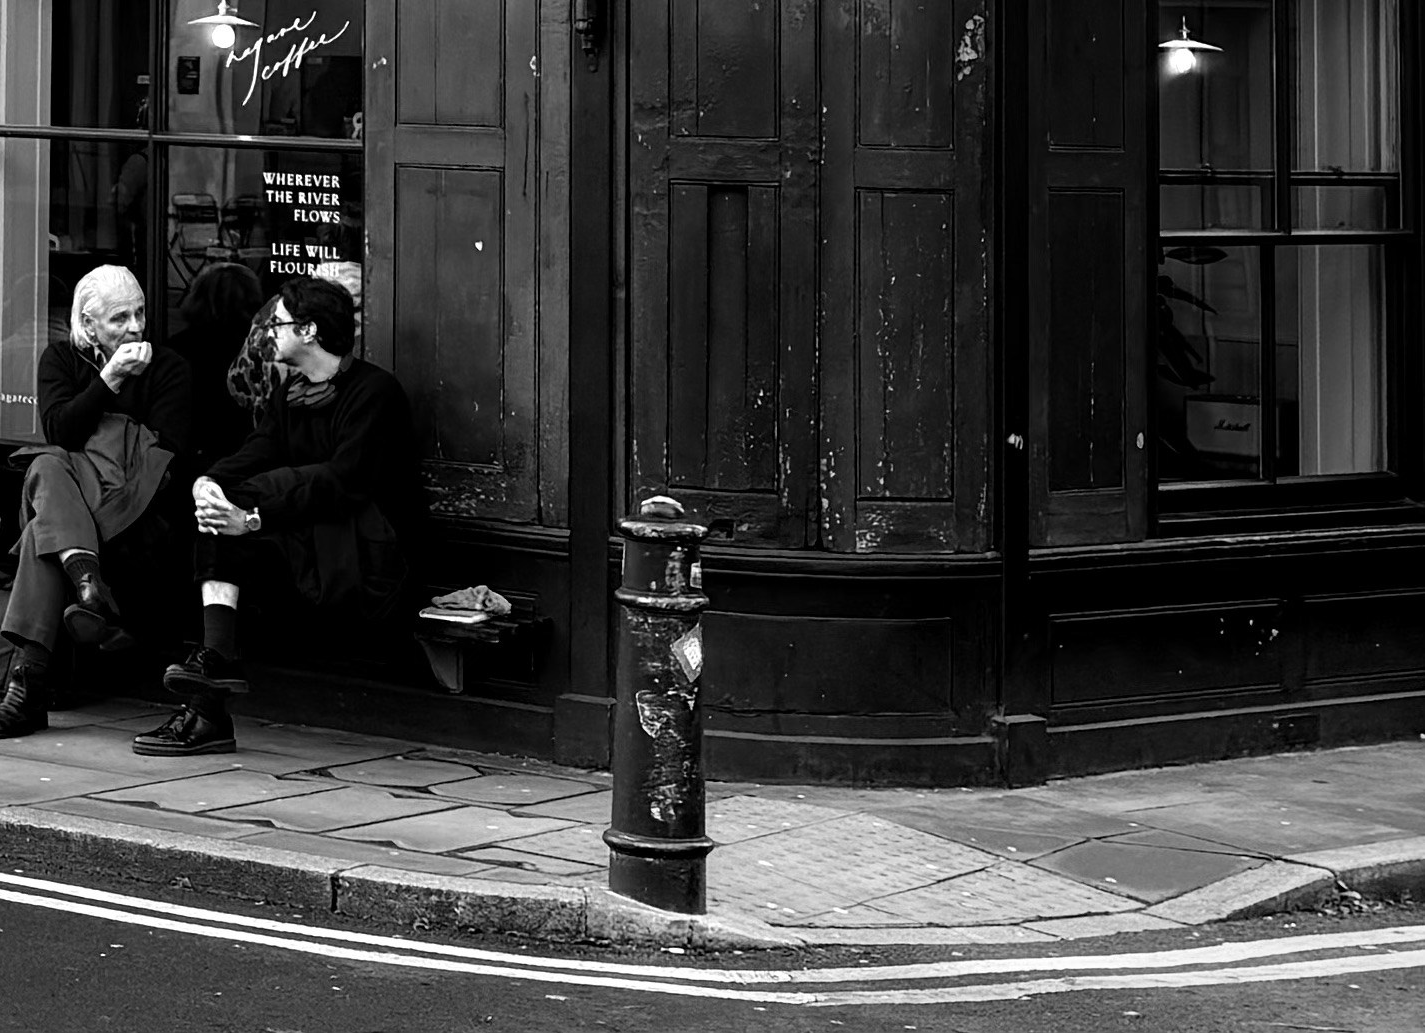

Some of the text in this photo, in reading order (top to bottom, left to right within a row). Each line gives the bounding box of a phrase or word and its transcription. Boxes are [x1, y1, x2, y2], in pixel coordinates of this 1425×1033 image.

[225, 10, 317, 106] nagare
[261, 20, 350, 80] coffee
[262, 171, 341, 188] WHEREVER
[265, 189, 341, 206] THE RIVER
[294, 208, 341, 224] FLOWS
[272, 242, 341, 260] LIFE WILL
[270, 260, 340, 277] FLOURISH
